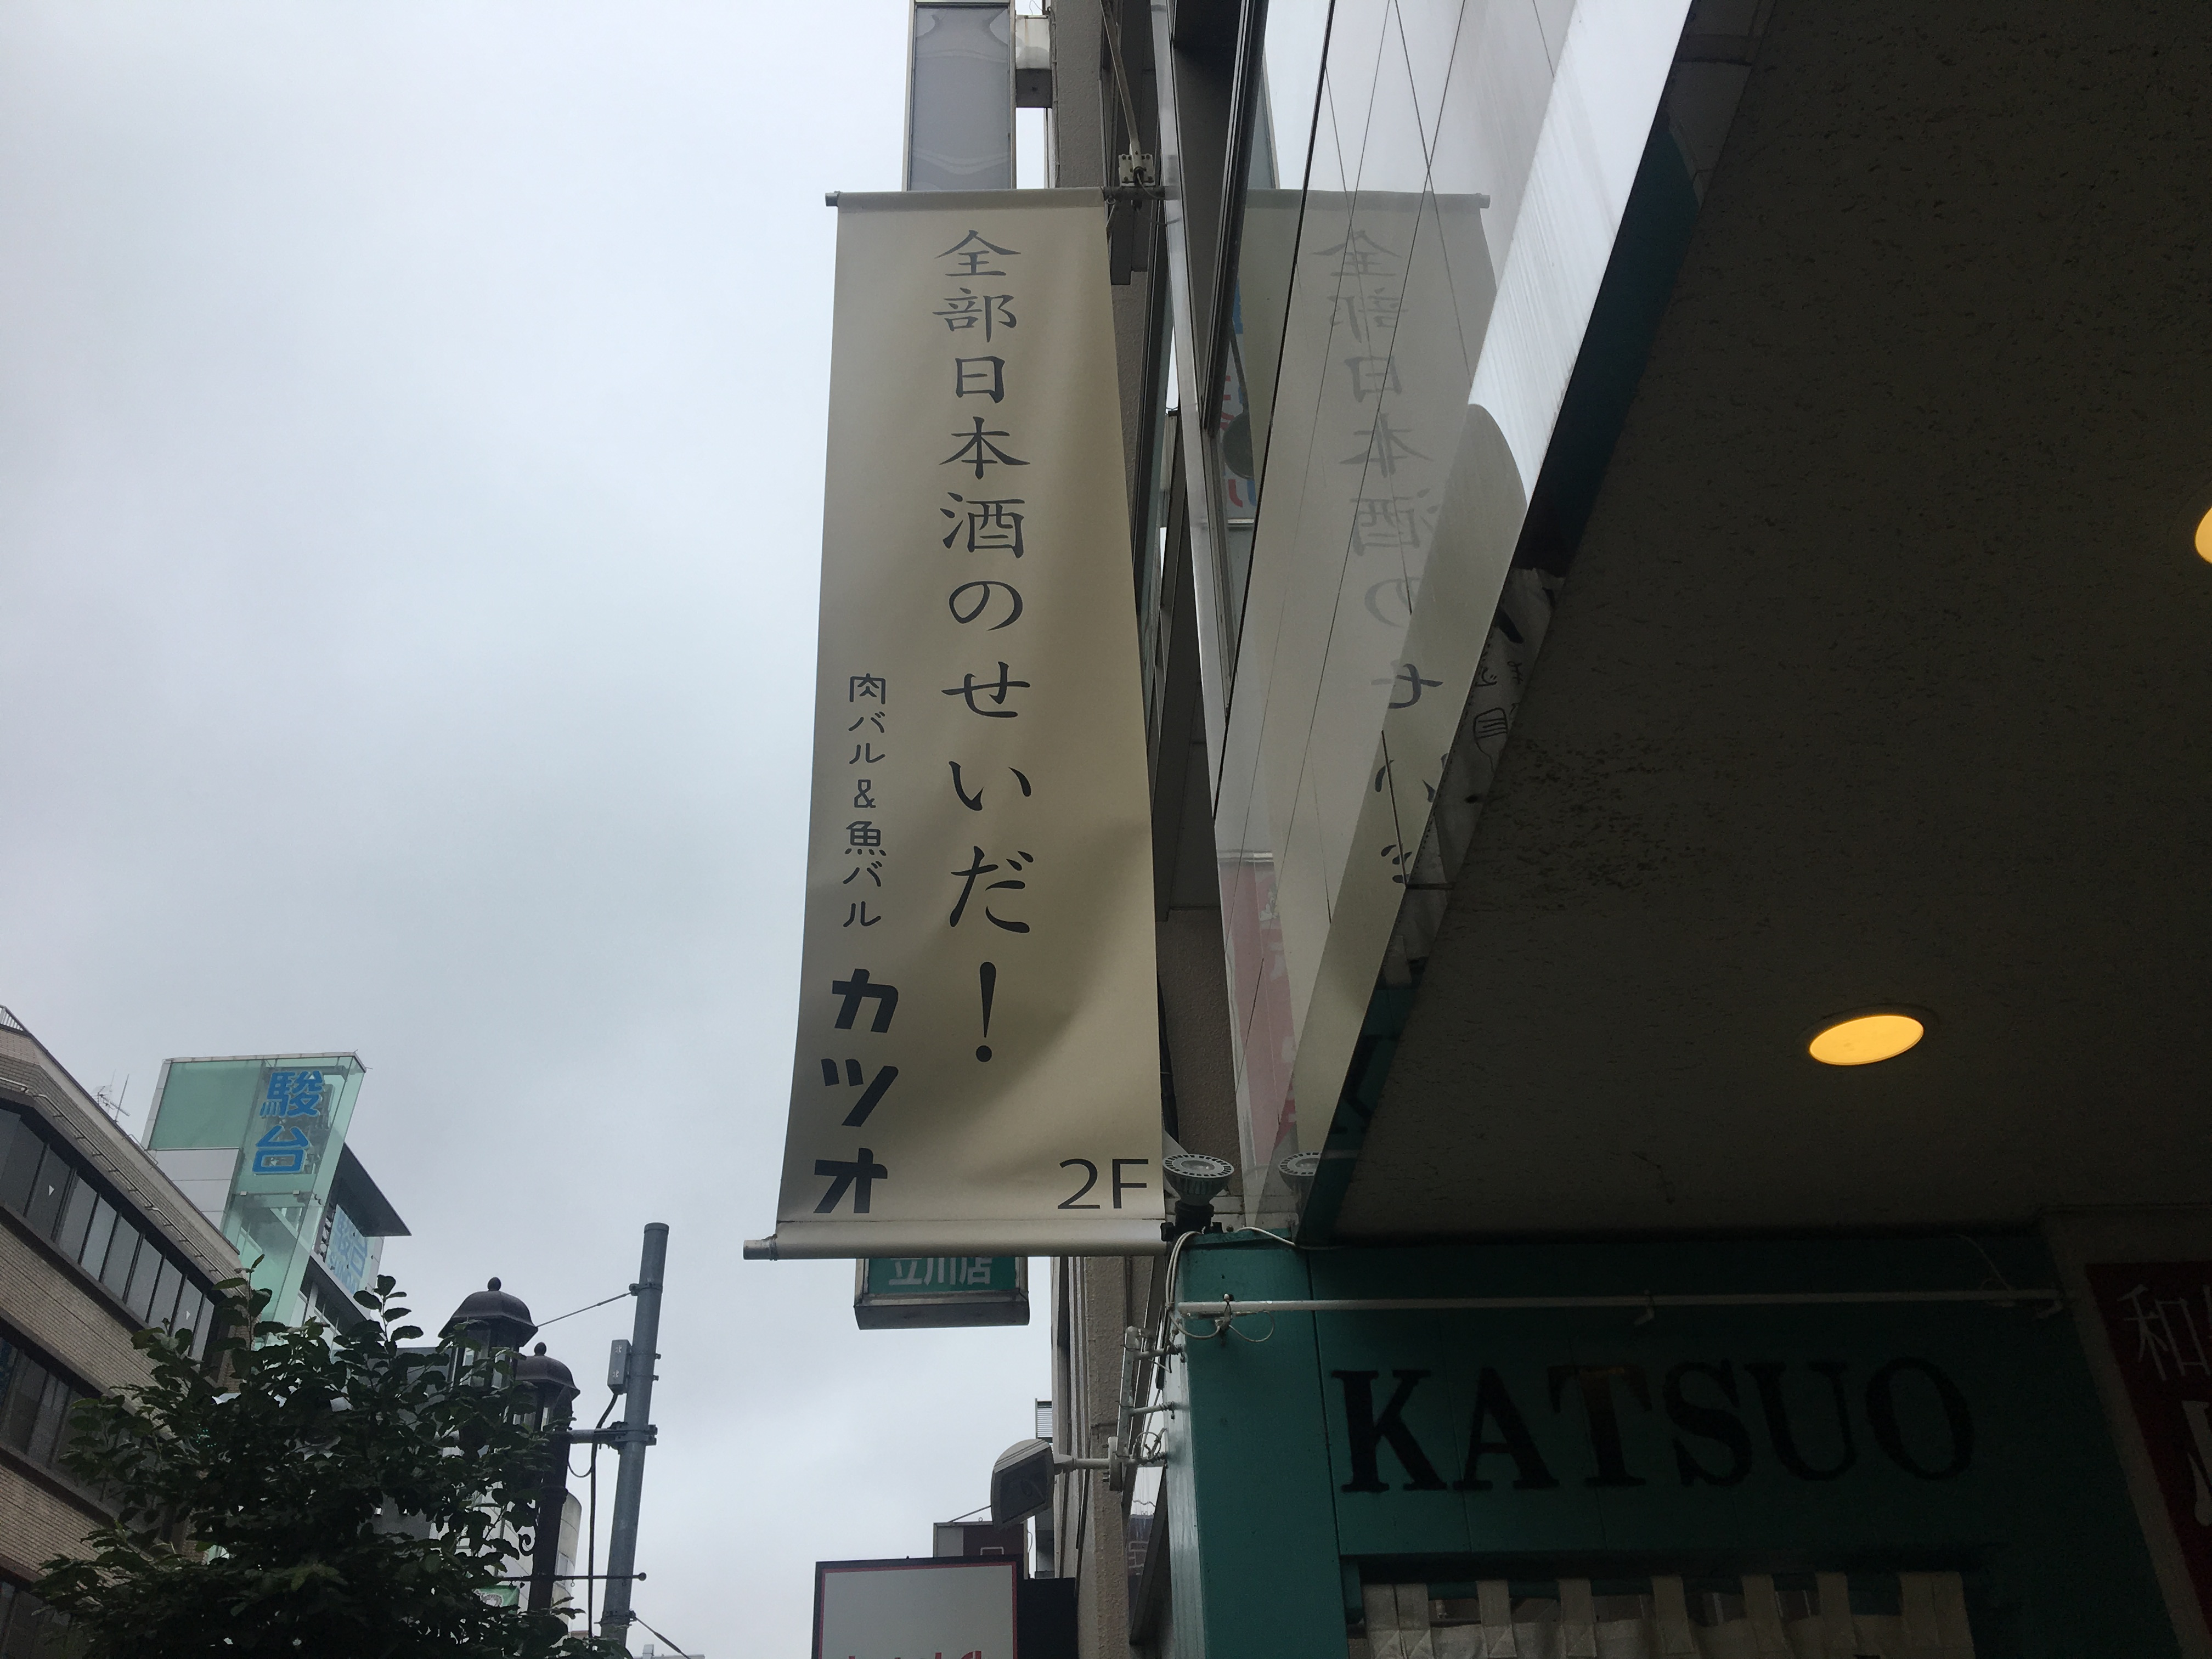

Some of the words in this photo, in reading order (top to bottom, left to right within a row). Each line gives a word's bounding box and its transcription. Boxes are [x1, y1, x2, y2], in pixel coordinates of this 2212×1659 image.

[932, 229, 1034, 1063] 全部日本酒のせいだ！
[252, 1070, 322, 1173] 駿台
[813, 968, 899, 1214] カツオ
[1057, 1158, 1149, 1210] 2F
[888, 1257, 992, 1285] 立川店
[1331, 1356, 1973, 1493] KATSUO
